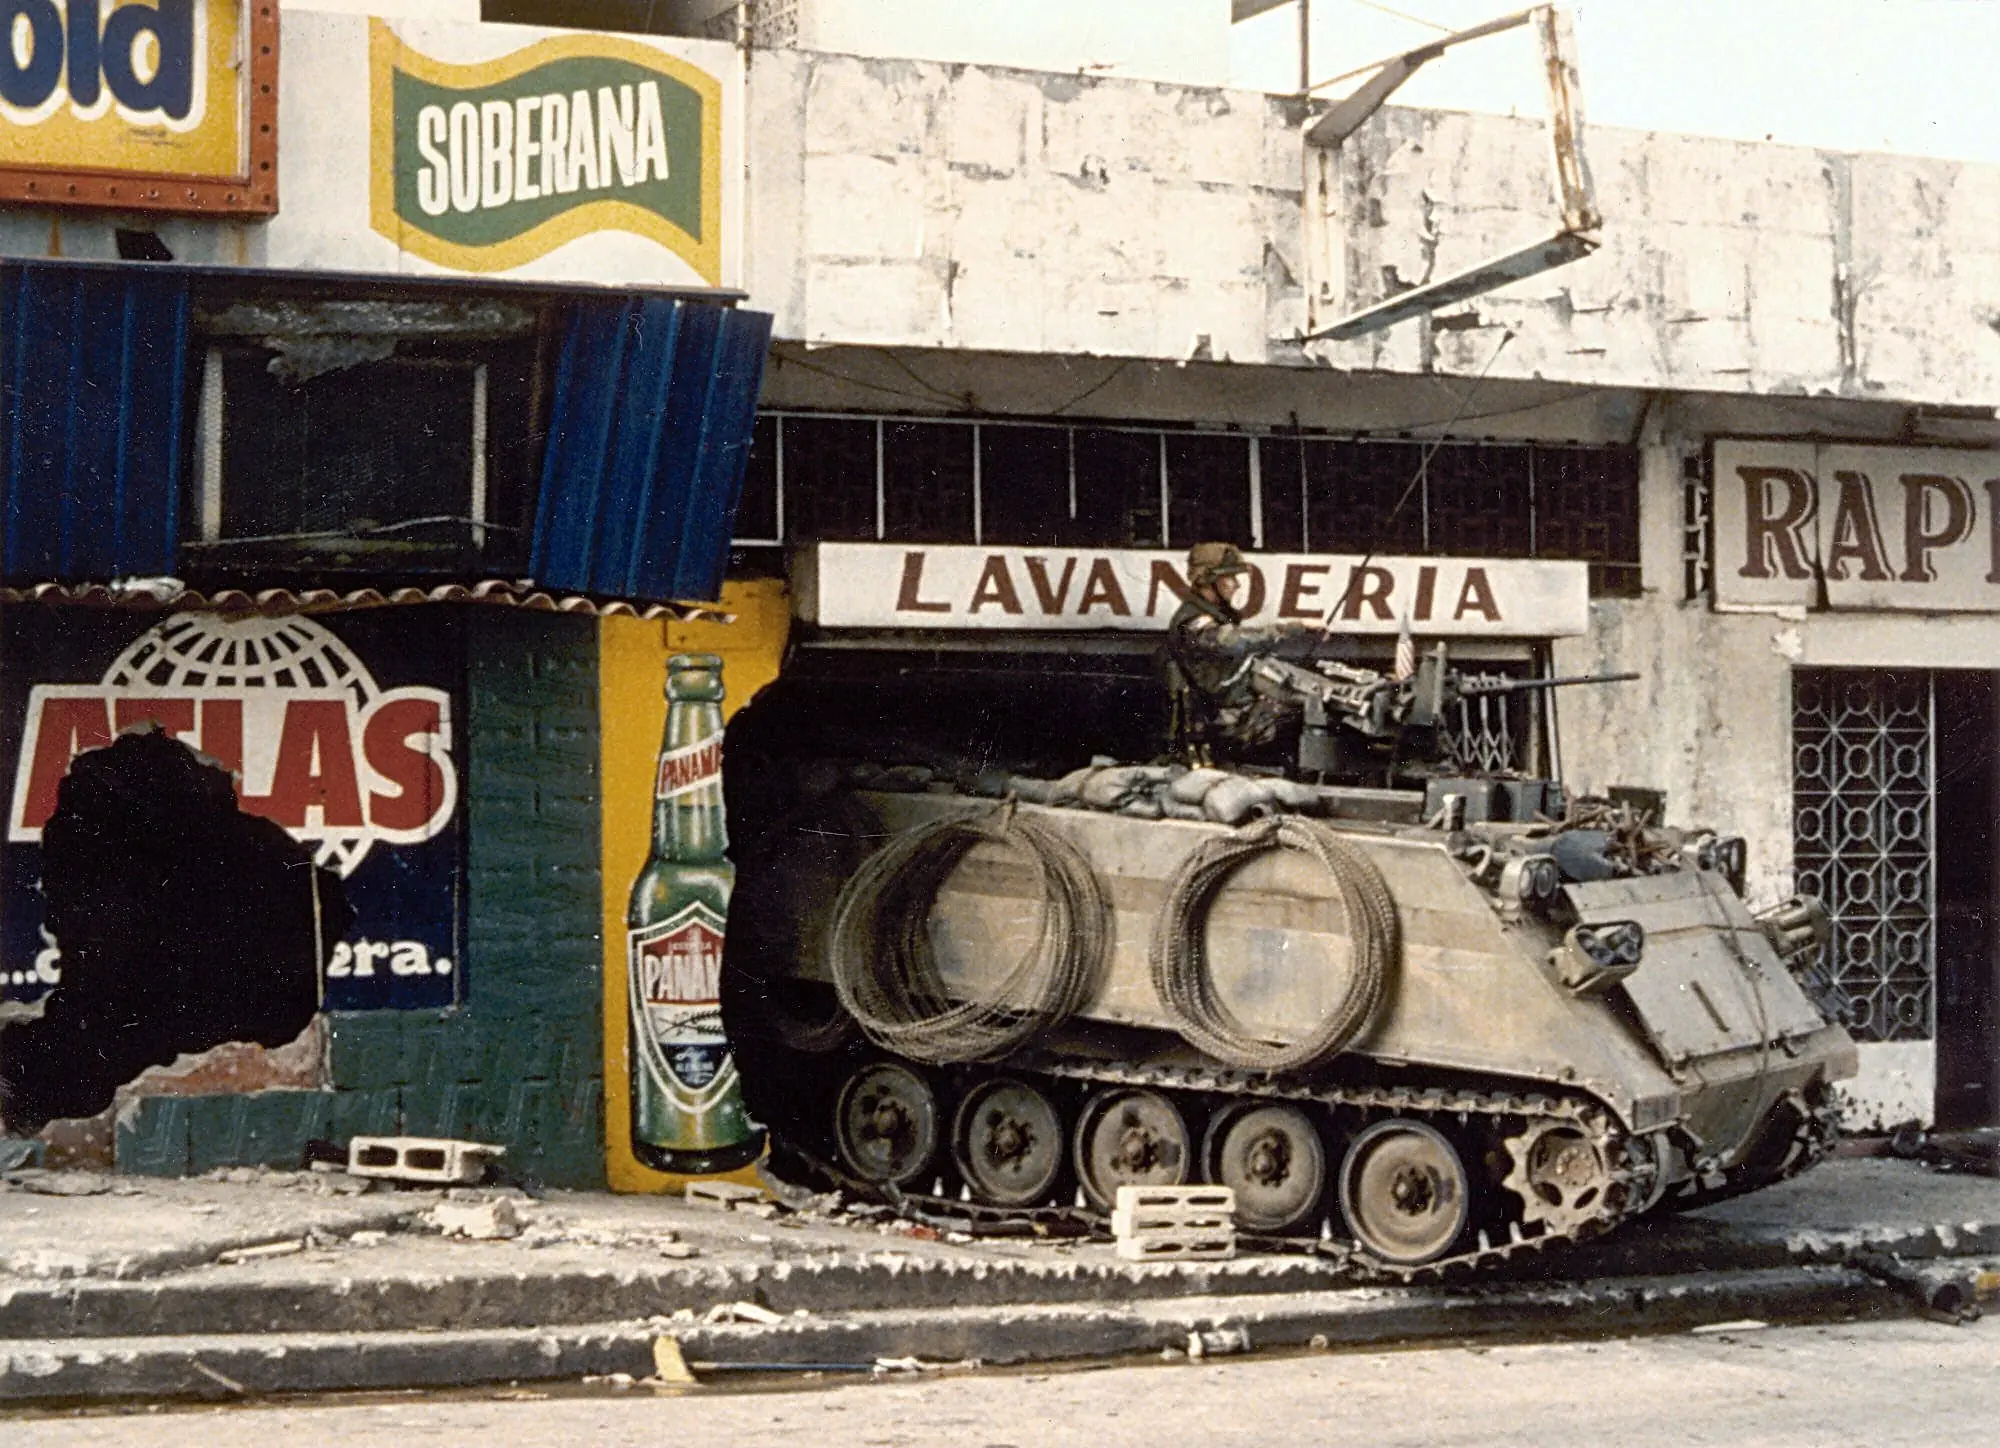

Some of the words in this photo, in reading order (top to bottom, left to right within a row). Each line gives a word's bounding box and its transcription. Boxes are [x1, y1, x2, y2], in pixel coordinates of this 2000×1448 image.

[0, 0, 200, 125] old
[417, 79, 670, 217] SOBERANA
[895, 550, 1504, 622] LAVANDERIA
